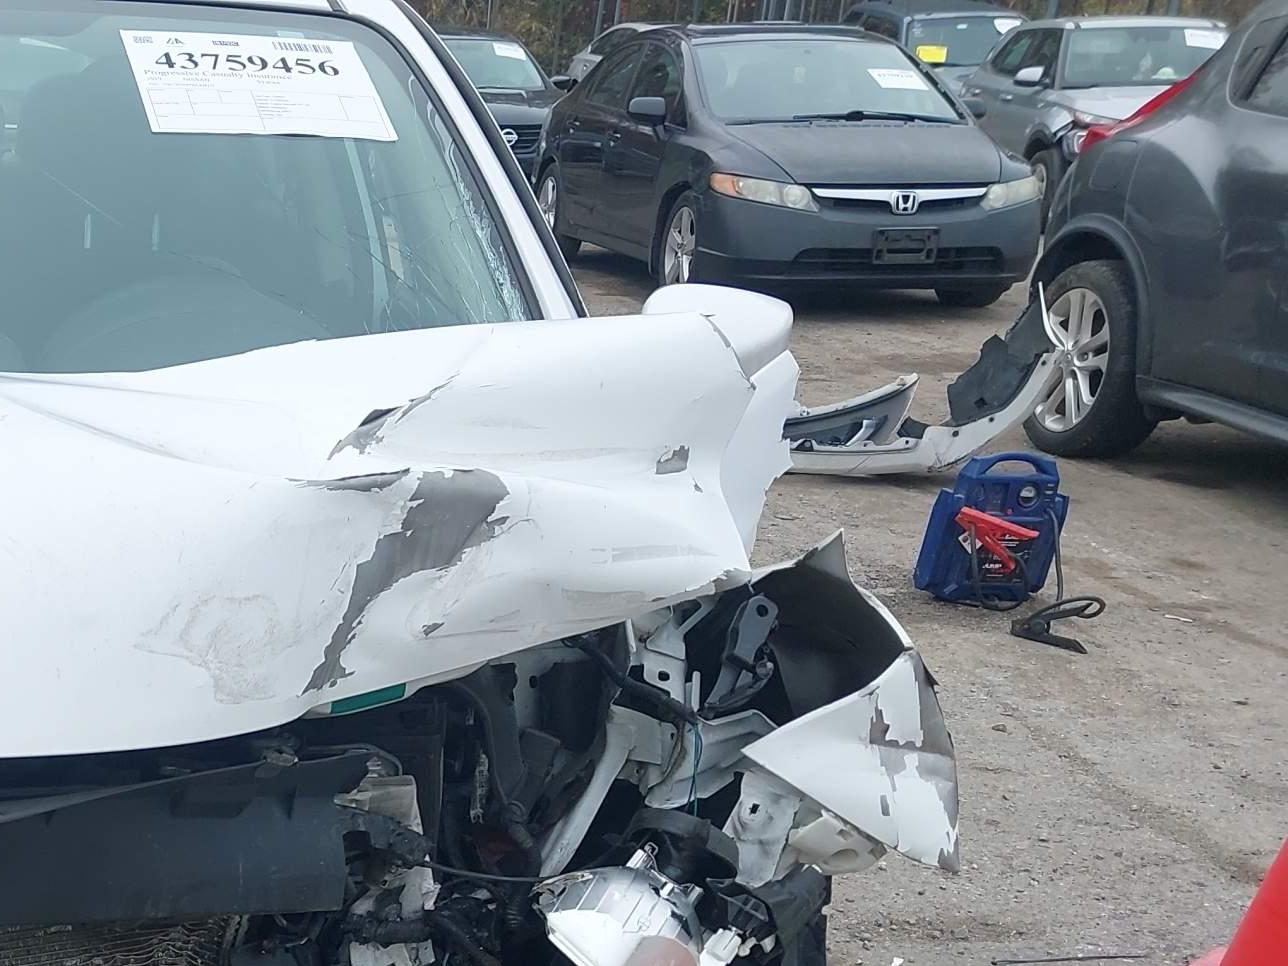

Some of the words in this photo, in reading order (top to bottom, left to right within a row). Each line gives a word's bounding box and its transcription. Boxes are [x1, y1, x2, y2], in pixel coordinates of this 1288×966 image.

[154, 51, 340, 77] 43759456
[143, 69, 200, 78] Progressive
[247, 72, 293, 81] Insurance
